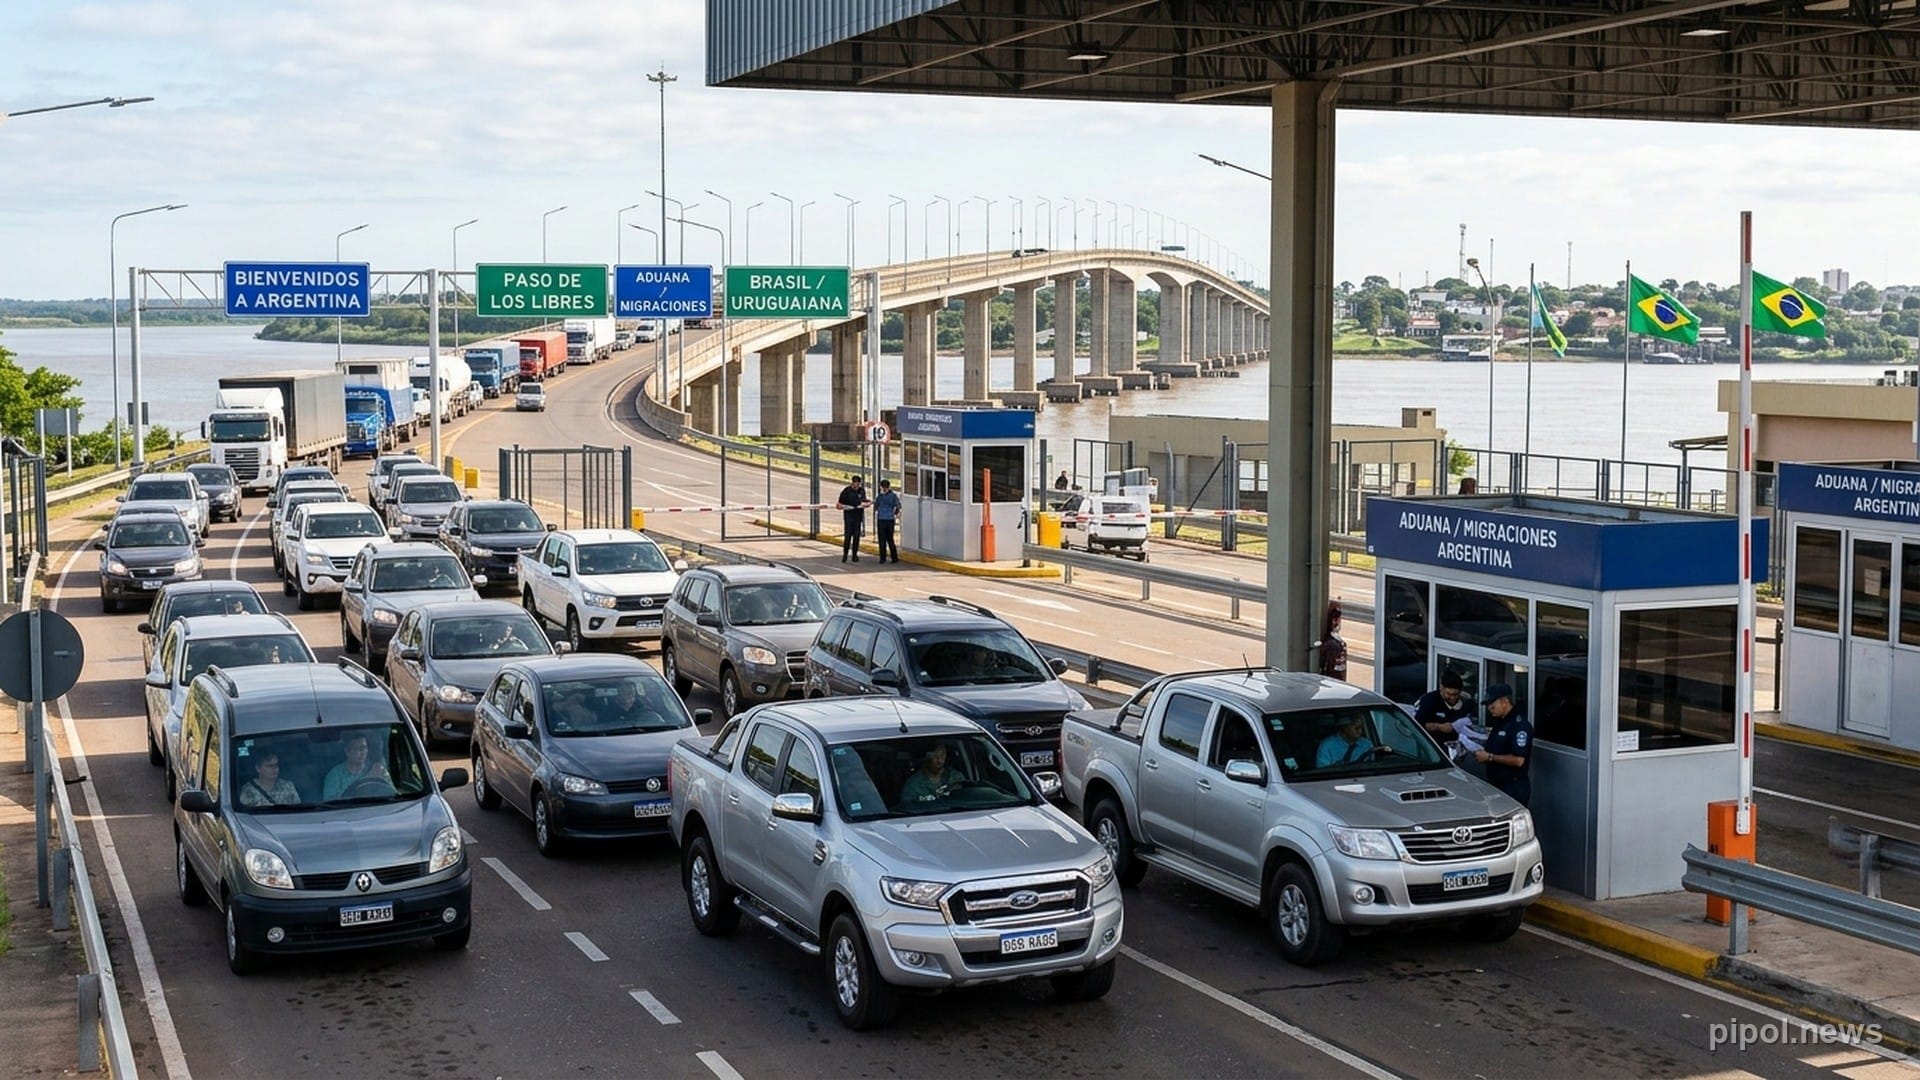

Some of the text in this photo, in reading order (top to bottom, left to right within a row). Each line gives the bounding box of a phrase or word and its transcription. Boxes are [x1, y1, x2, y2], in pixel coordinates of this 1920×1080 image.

[235, 271, 360, 287] BIENVENIDOS
[504, 272, 582, 288] PASO DE
[636, 271, 690, 283] ADUANA
[750, 275, 826, 290] BRASIL /
[235, 293, 361, 308] A ARGENTINA
[491, 294, 595, 310] LOS LIBRES
[620, 300, 707, 312] MIGRACIONES
[731, 296, 843, 310] URUGUAIANA
[1815, 473, 1868, 492] ADUANA
[1854, 497, 1920, 517] ARGENTIN
[1399, 511, 1558, 548] ADUANA / MIGRACIONES
[1437, 541, 1513, 569] ARGENTINA
